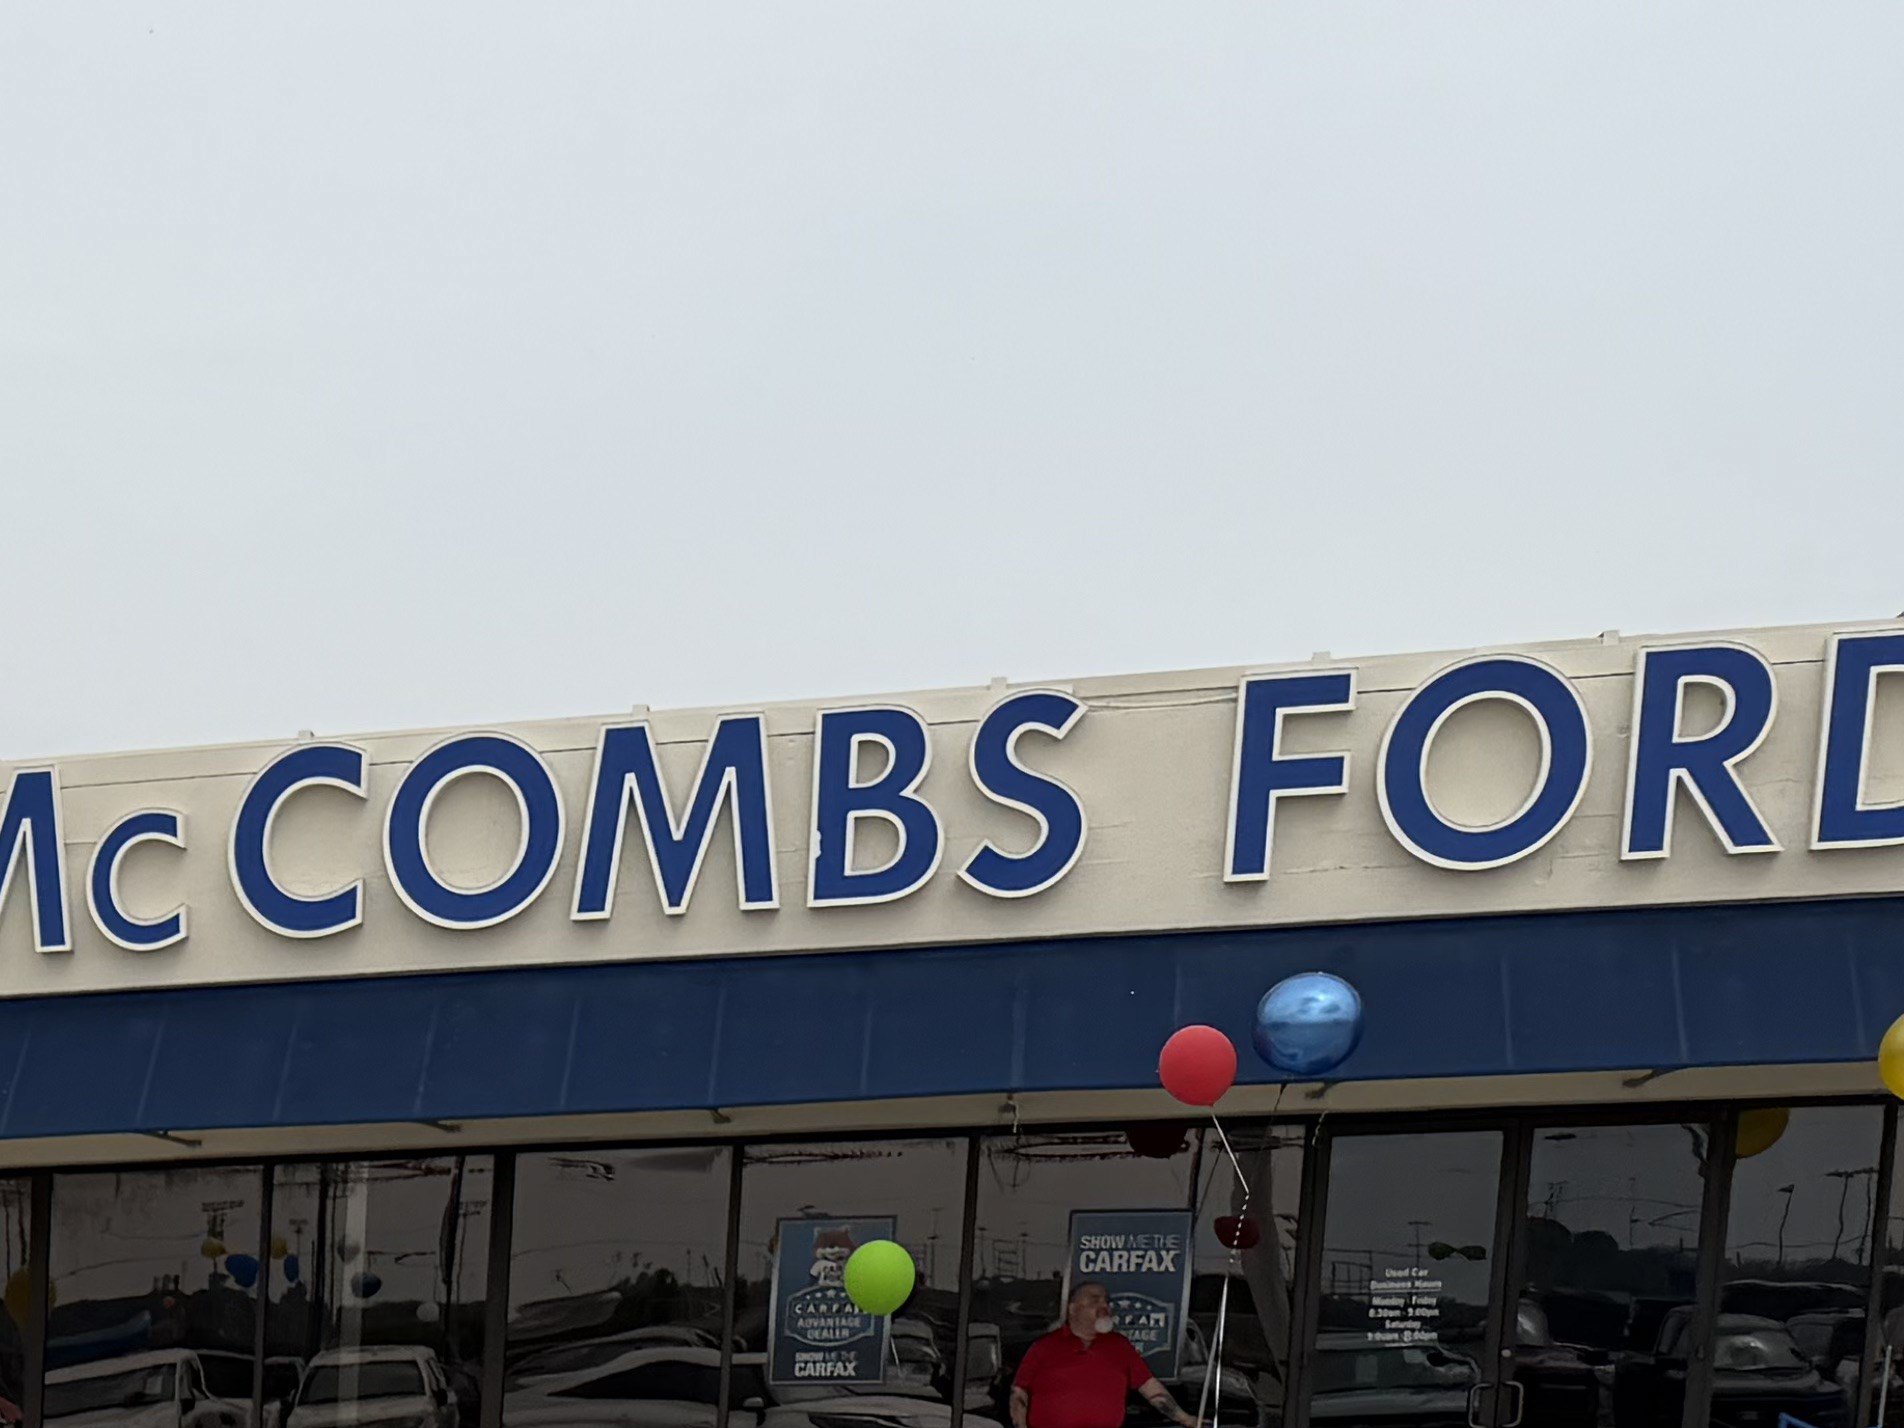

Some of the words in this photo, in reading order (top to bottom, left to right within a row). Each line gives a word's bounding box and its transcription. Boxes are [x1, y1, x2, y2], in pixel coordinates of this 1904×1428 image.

[1080, 1234, 1126, 1249] SHOW
[1079, 1250, 1181, 1273] CARFAX
[1385, 1268, 1409, 1278] Used
[1411, 1267, 1429, 1277] Car
[797, 1317, 861, 1328] ADVANTAGE
[806, 1328, 850, 1339] DEALER
[794, 1361, 858, 1378] CARFAX
